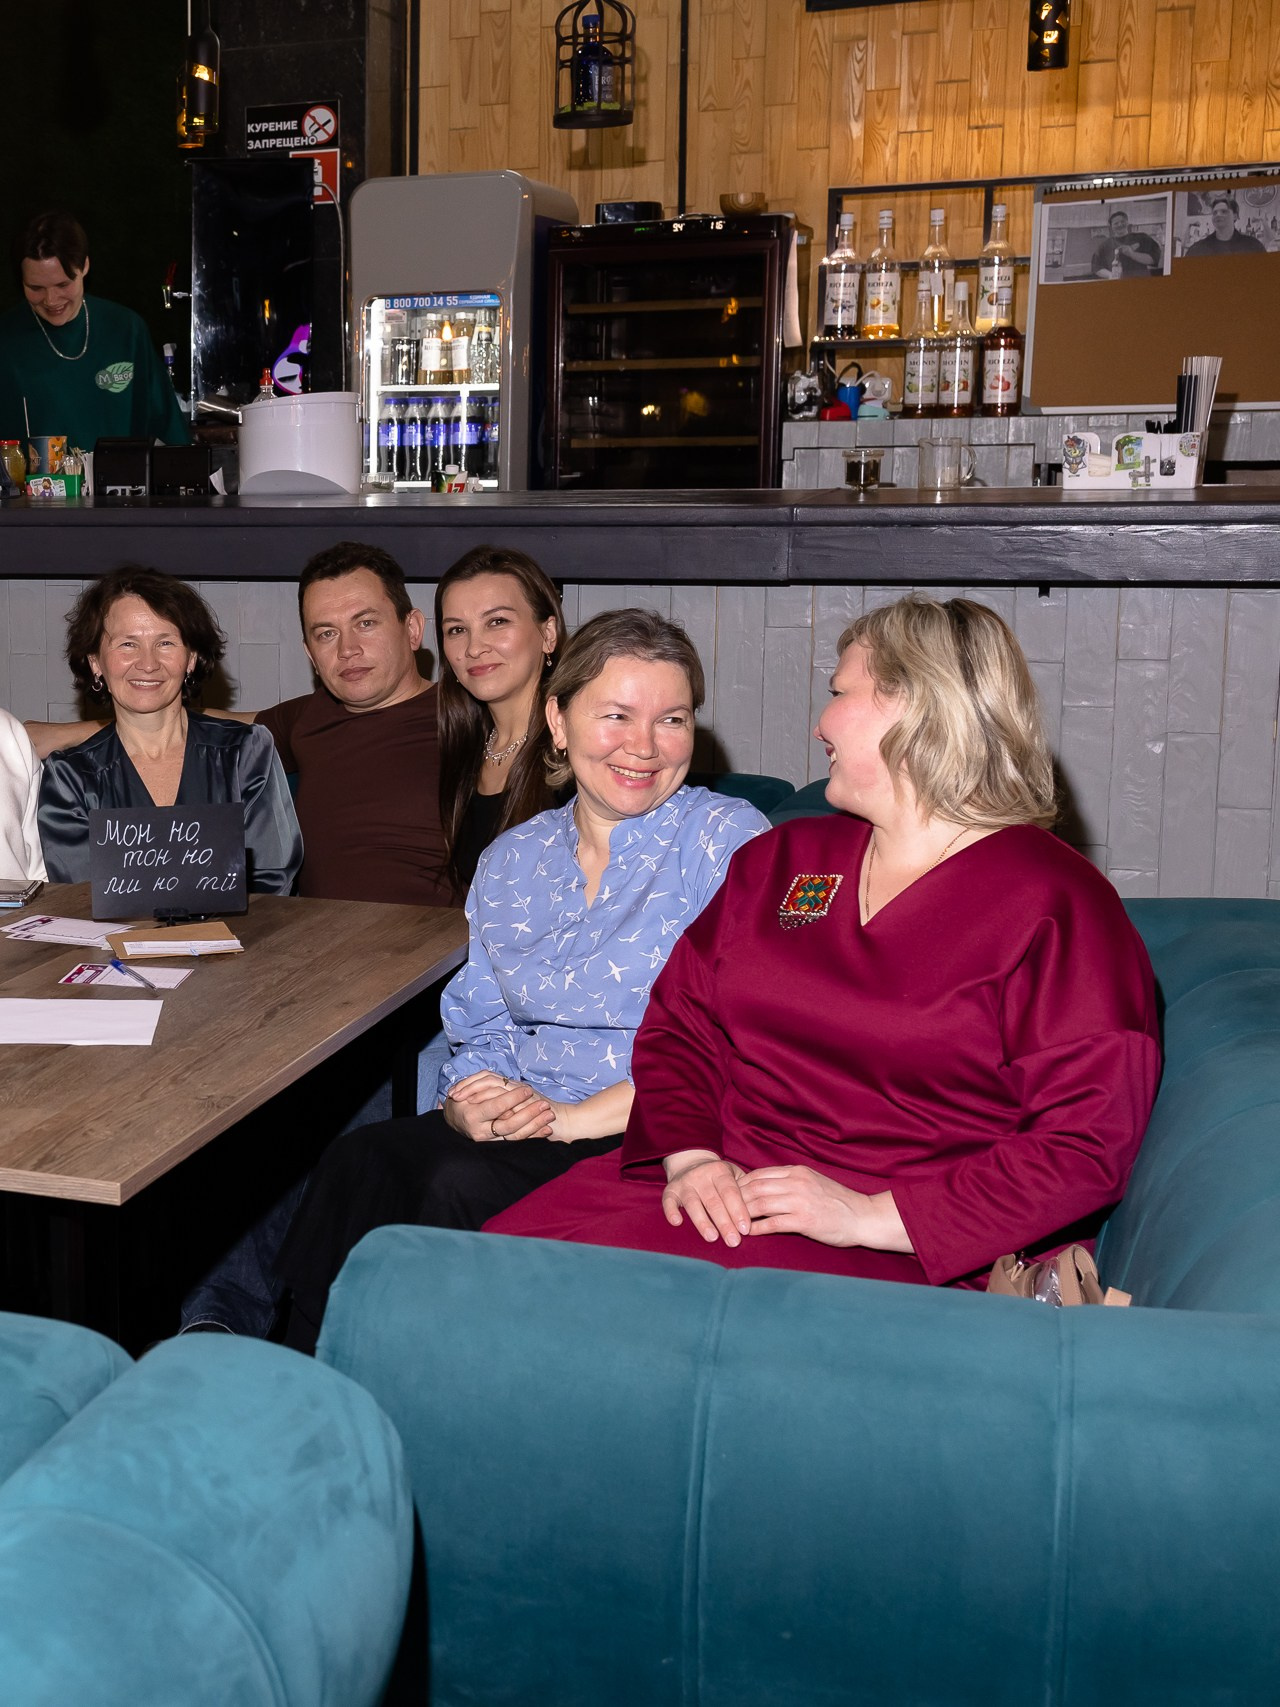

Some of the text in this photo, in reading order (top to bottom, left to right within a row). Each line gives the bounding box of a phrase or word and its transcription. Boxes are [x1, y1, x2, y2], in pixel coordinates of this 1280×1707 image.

[247, 120, 298, 133] КУРЕНИЕ
[247, 135, 318, 149] ЗАПРЕЩЕНО
[385, 295, 459, 309] 8 800 700 14 55
[97, 819, 156, 847] Мон
[123, 848, 172, 868] тон
[104, 876, 143, 895] ми
[152, 876, 179, 892] но
